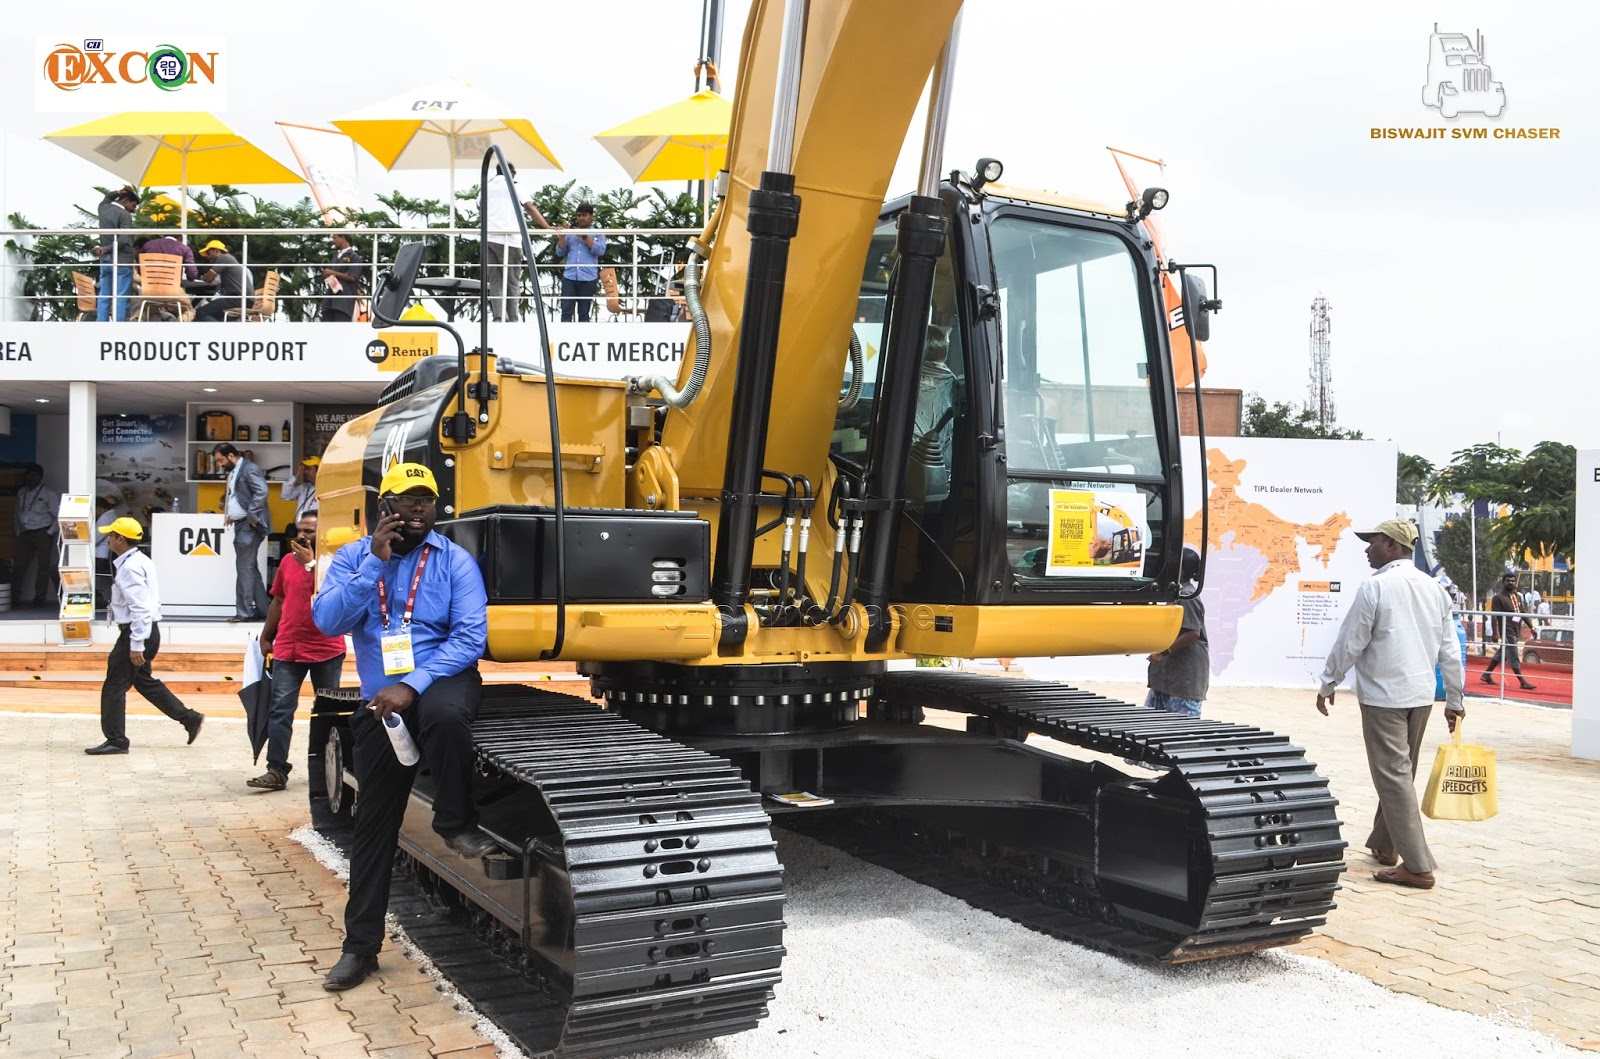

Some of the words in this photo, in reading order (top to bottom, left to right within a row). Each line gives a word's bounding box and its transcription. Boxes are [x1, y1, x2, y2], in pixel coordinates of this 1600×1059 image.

[411, 100, 458, 112] CAT
[100, 341, 201, 361] PRODUCT
[207, 341, 308, 361] SUPPORT
[368, 346, 386, 357] CAT
[392, 347, 434, 357] Rental
[558, 341, 600, 362] CAT
[315, 414, 329, 422] WE
[330, 414, 345, 422] ARE
[102, 435, 114, 443] Get
[115, 435, 134, 443] More
[382, 420, 415, 478] CAT
[406, 468, 425, 478] CAT
[1087, 481, 1116, 489] Network
[1253, 485, 1269, 493] TIPL
[1294, 486, 1324, 494] Network
[179, 527, 225, 556] CAT
